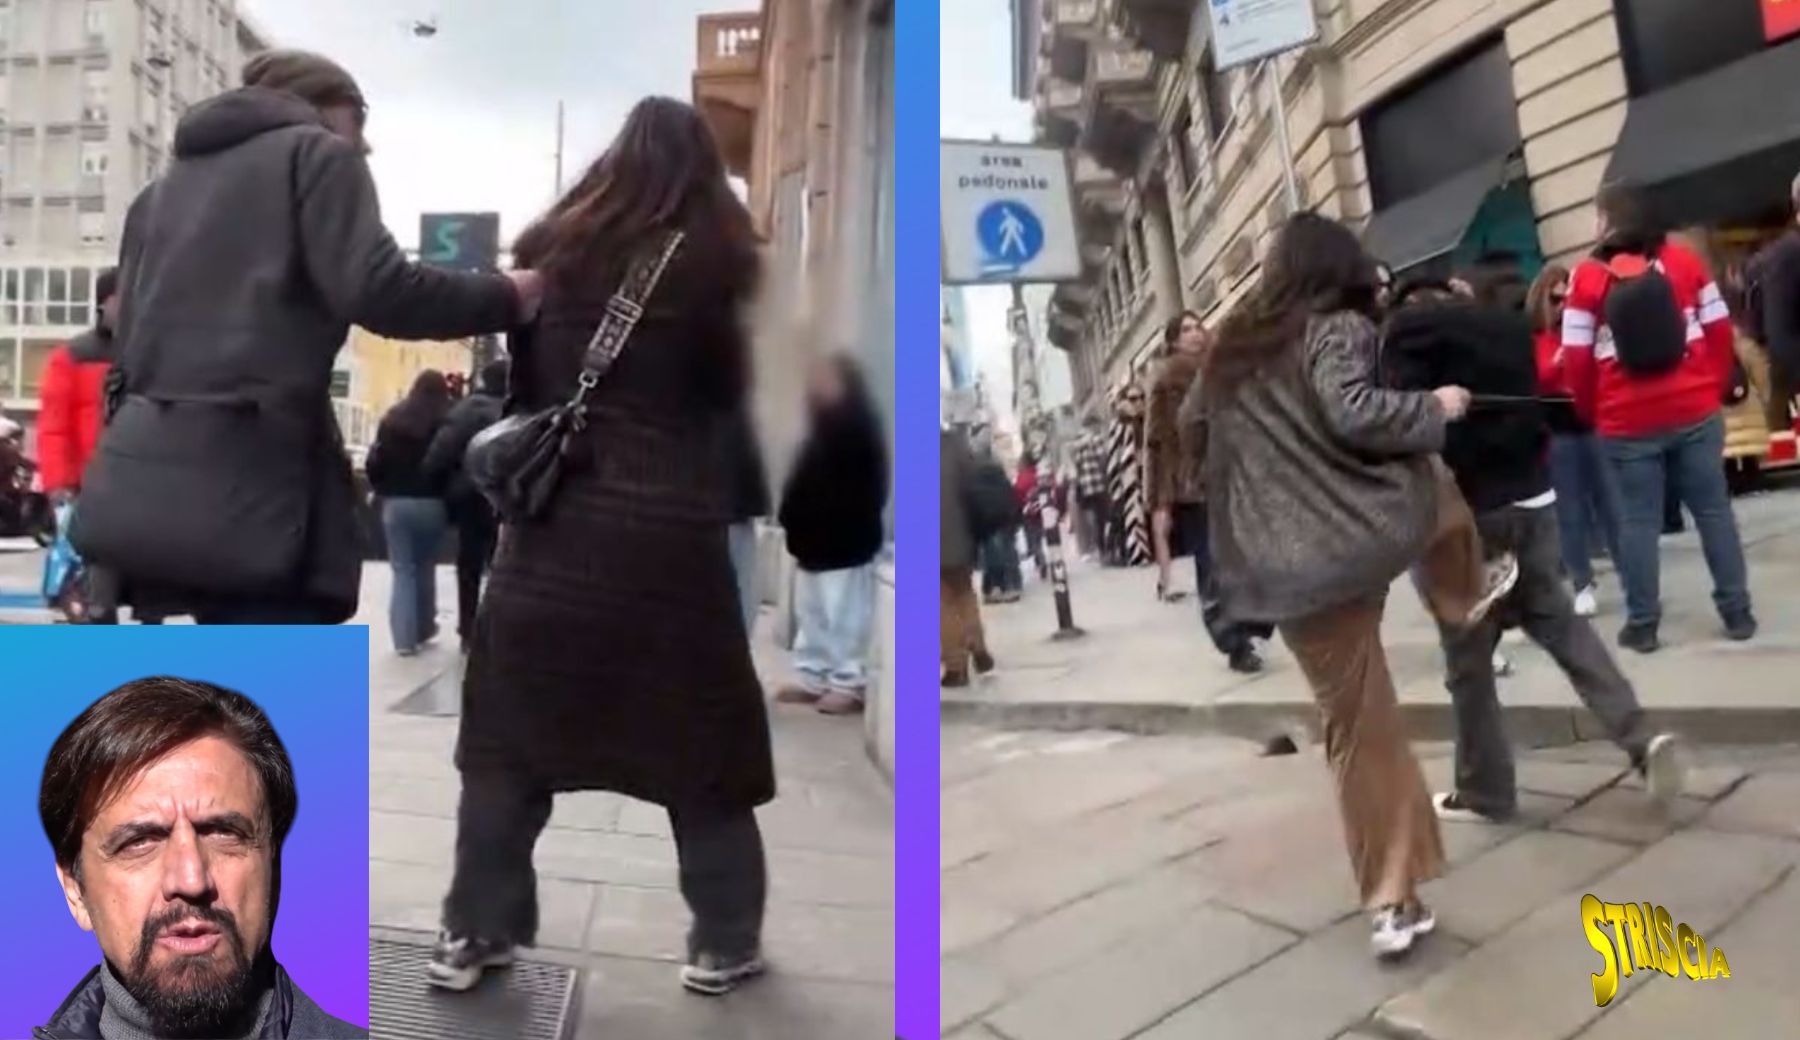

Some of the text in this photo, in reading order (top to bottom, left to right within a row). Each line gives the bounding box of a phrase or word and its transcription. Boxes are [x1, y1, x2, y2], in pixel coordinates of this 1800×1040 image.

[981, 156, 1022, 167] area
[958, 174, 1048, 190] pedonale
[431, 220, 464, 261] S
